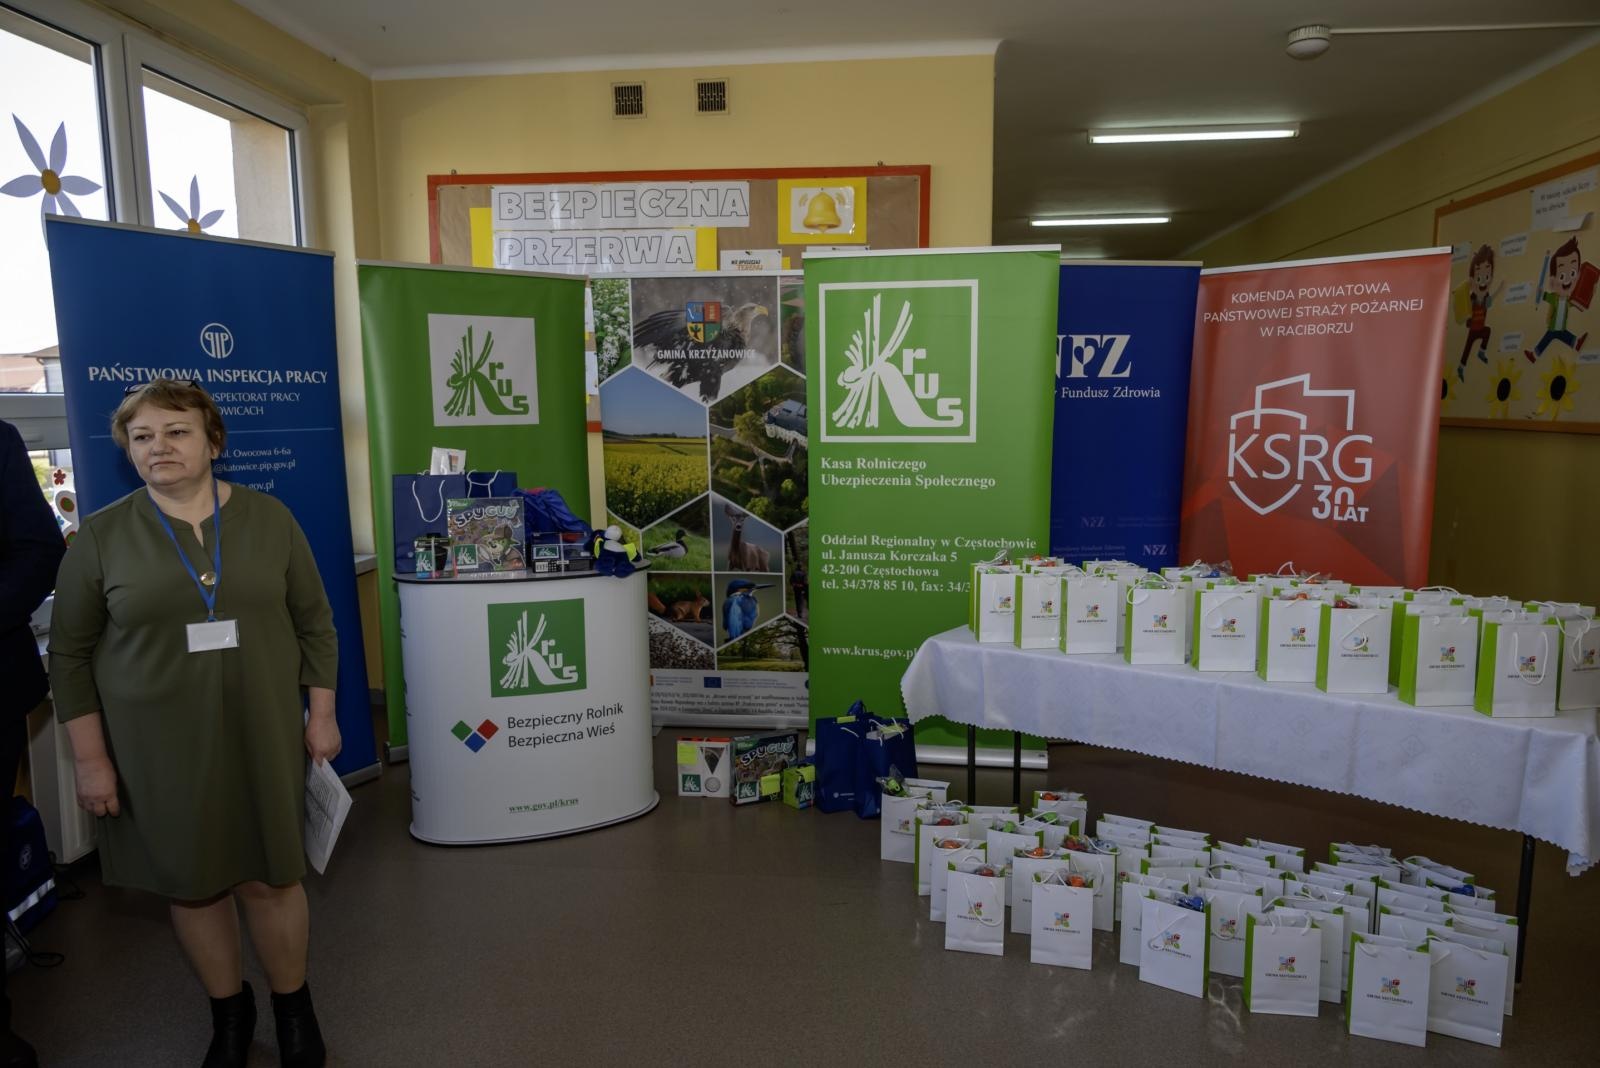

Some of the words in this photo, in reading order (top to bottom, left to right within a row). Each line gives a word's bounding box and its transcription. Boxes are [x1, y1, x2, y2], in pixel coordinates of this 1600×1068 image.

[498, 188, 749, 220] BEZPIECZNA
[499, 235, 694, 266] PRZERWA
[1231, 288, 1295, 304] KOMENDA
[1298, 281, 1391, 299] POWIATOWA
[1203, 308, 1293, 323] PAŃSTWOWEJ
[1296, 302, 1348, 319] STRAŻY
[1350, 298, 1424, 314] POŻARNEJ
[1260, 325, 1275, 337] W
[1277, 322, 1354, 337] RACIBORZU
[657, 349, 687, 360] GMINA
[88, 362, 201, 383] PAŃSTWOWA
[207, 368, 282, 386] INSPEKCJA
[286, 370, 328, 384] PRACY
[209, 392, 267, 402] NSPEKTORAT
[270, 392, 301, 402] PRACY
[1061, 386, 1109, 398] Fundusz
[1113, 386, 1161, 398] Zdrowia
[217, 406, 264, 416] OWICACH
[233, 448, 272, 458] Owocowa
[1227, 433, 1373, 483] KSRG
[213, 459, 296, 473] @katowice.pip.gov.pl
[821, 457, 852, 469] Kasa
[856, 457, 927, 472] Rolniczego
[821, 473, 912, 489] Ubezpieczenia
[1333, 505, 1369, 522] LAT
[871, 534, 936, 550] Regionalny
[940, 539, 950, 547] w
[954, 536, 1037, 550] Częstochowie
[821, 550, 836, 561] ul.
[839, 551, 886, 562] Janusza
[889, 551, 947, 563] Korczaka
[950, 552, 958, 562] 5
[821, 564, 860, 575] 42-200
[863, 564, 939, 579] Częstochowa
[821, 579, 839, 590] tel.
[842, 579, 880, 590] 34/378
[883, 580, 897, 590] 85
[921, 580, 944, 592] fax:
[947, 581, 970, 592] 34/3
[507, 710, 583, 730] Bezpieczny
[586, 702, 624, 720] Rolnik
[508, 729, 584, 748] Bezpieczna
[587, 722, 616, 738] Wieś
[509, 798, 579, 813] www.gov.pl/krus
